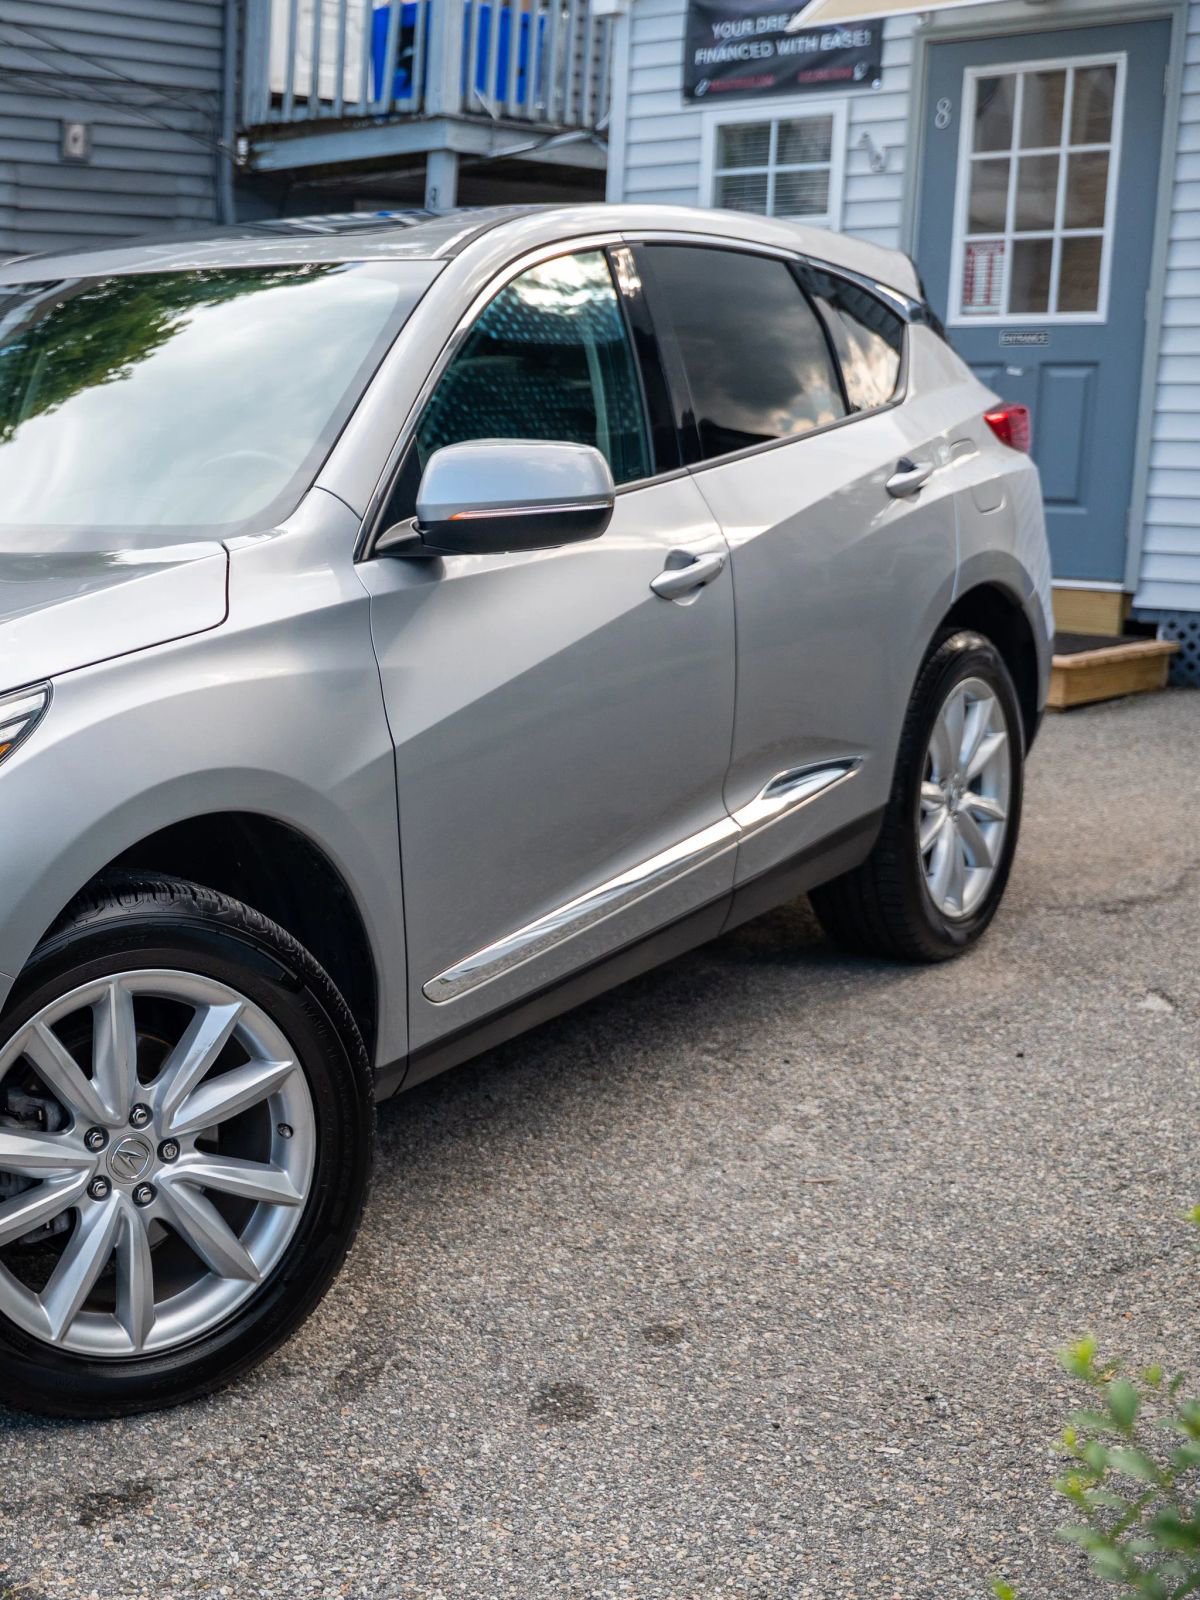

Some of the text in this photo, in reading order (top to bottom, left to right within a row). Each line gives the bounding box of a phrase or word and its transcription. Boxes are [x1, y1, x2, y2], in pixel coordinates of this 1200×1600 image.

[712, 18, 753, 39] YOUR
[694, 29, 871, 65] FINANCED WITH EASE!
[934, 96, 952, 130] 8
